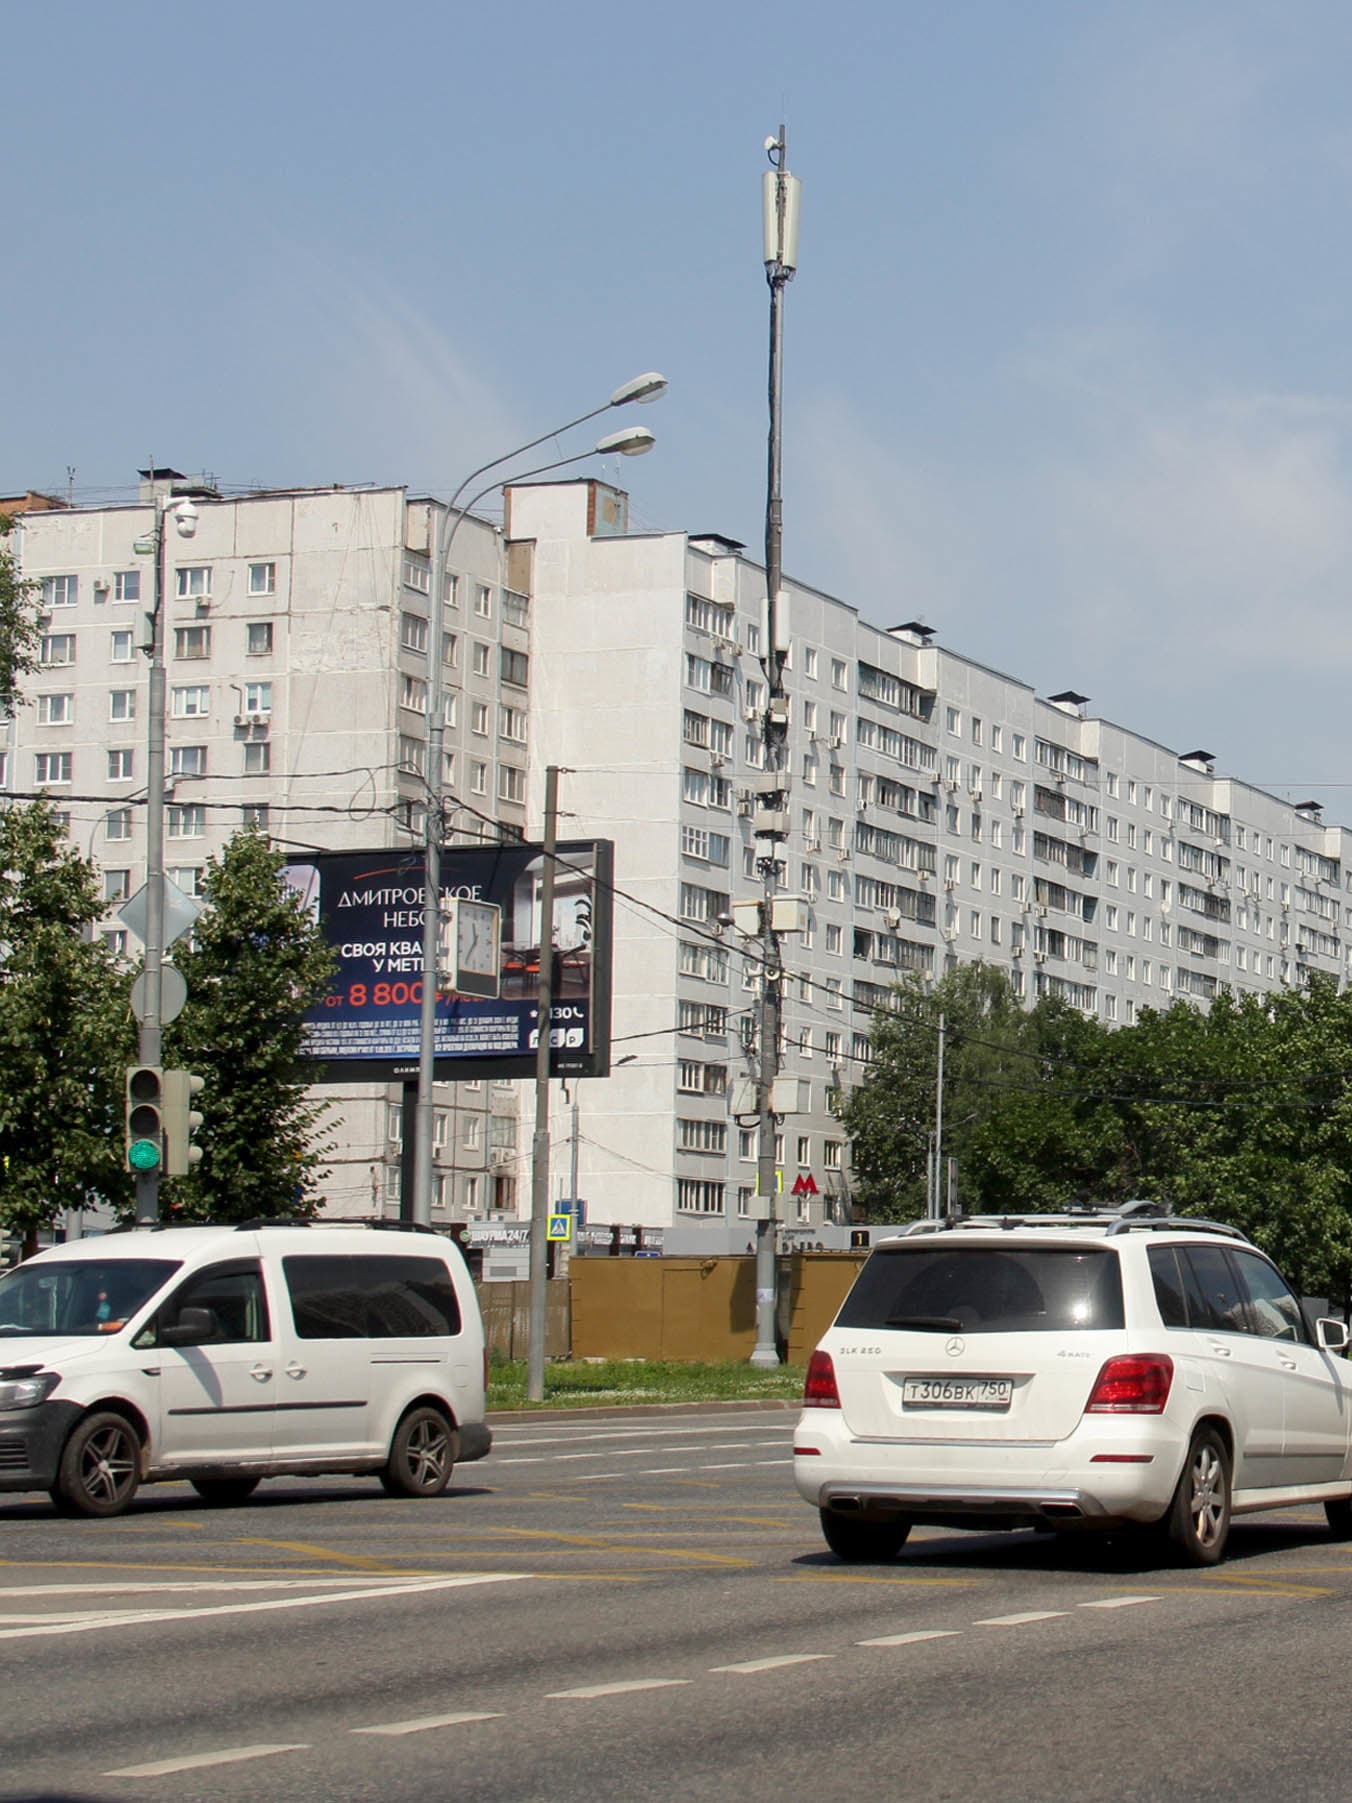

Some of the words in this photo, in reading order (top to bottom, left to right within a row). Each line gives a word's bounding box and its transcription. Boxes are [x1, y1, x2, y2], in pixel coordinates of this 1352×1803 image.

[341, 942, 386, 958] СВОЯ
[372, 958, 385, 973] У
[348, 983, 368, 1007] 8
[910, 1381, 976, 1400] Т306ВК
[980, 1381, 1007, 1396] 750
